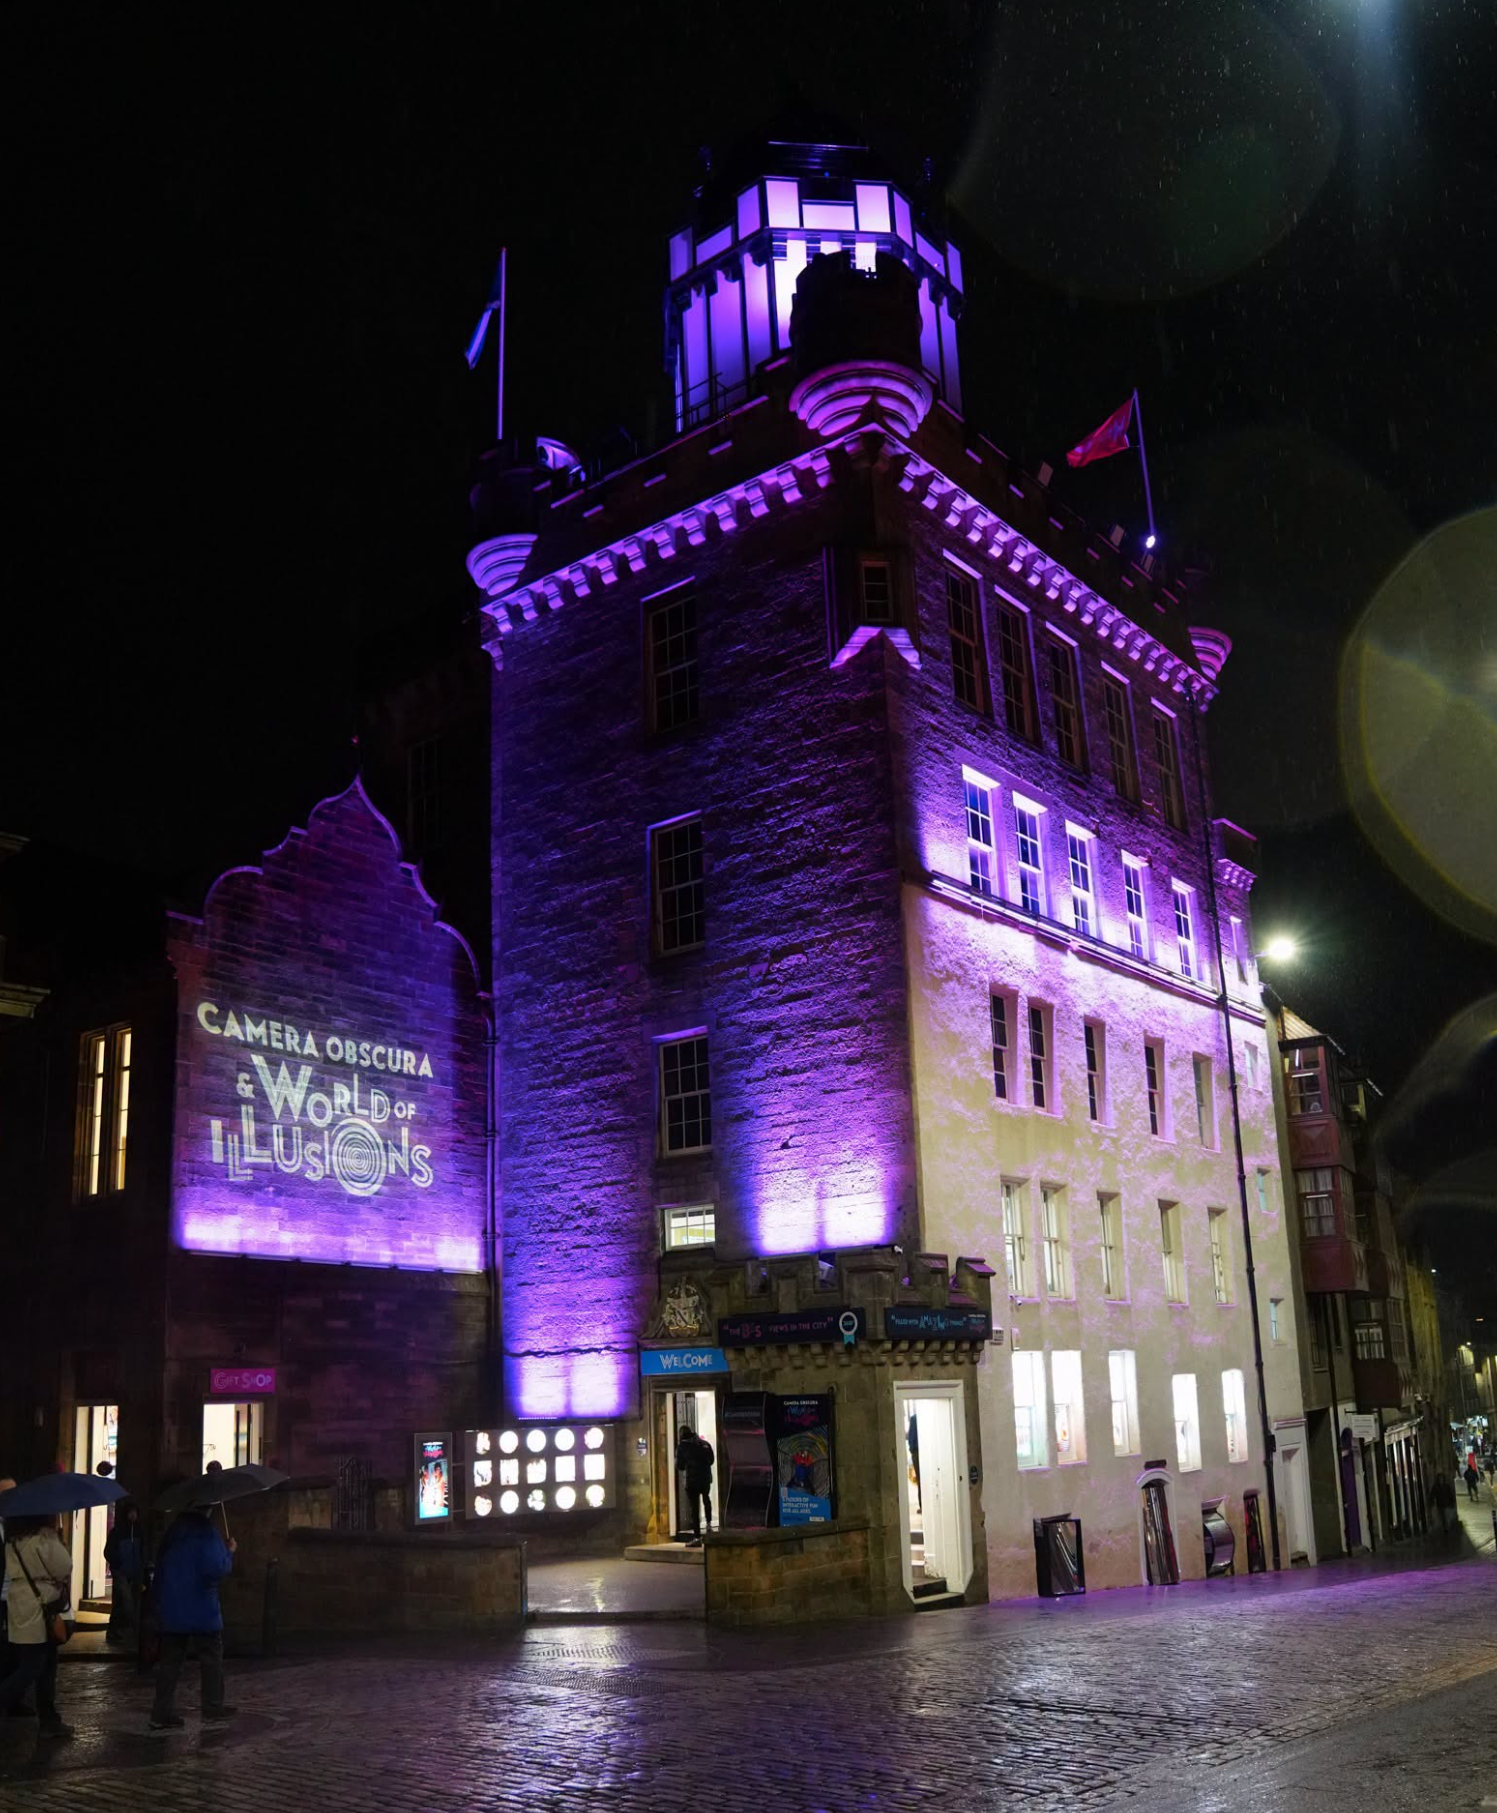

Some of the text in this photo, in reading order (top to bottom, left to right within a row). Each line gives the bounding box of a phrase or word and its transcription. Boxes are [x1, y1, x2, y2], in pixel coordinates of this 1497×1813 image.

[196, 1001, 434, 1079] CAMERA OBSCURA
[236, 1053, 416, 1128] & WORLD OF
[210, 1104, 434, 1197] ILLUSIONS
[798, 1321, 811, 1331] THE
[213, 1371, 272, 1390] GIFT SHOP
[658, 1352, 713, 1370] WELCOME
